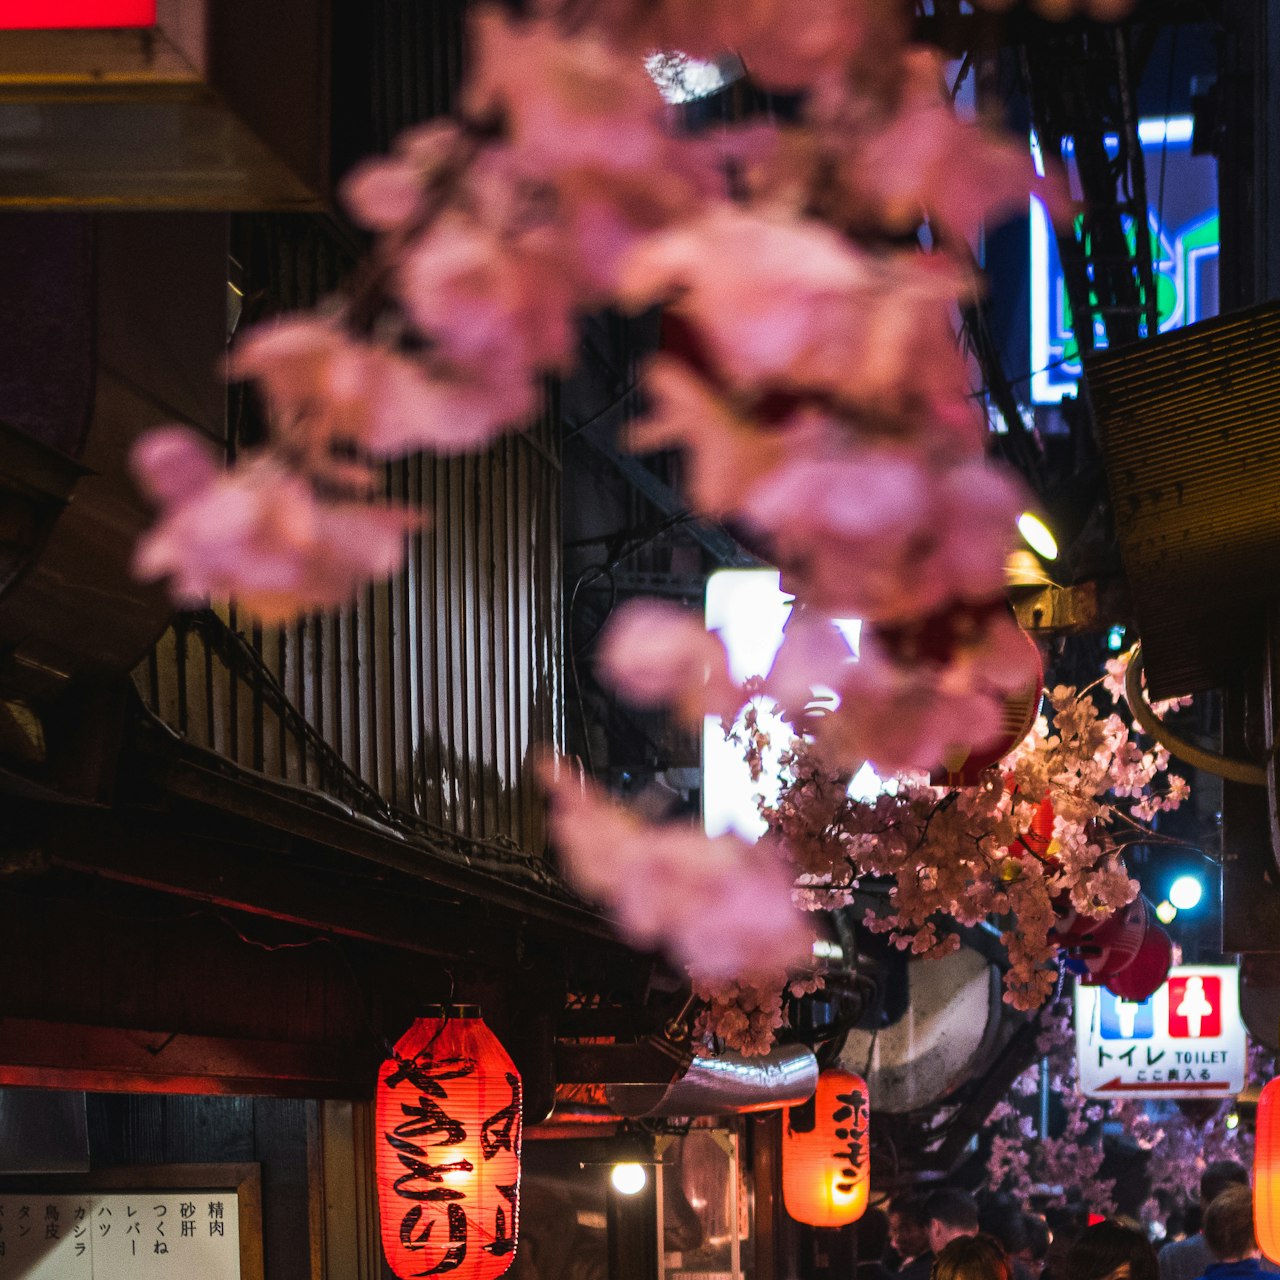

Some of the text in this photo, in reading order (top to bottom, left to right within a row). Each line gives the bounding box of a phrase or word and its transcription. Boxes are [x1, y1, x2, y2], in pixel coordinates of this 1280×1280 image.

[1098, 1045, 1229, 1068] トイレ TOILET
[18, 1204, 32, 1238] タン
[44, 1204, 60, 1240] 鳥皮
[72, 1204, 88, 1257] カシラ
[98, 1205, 113, 1237] ハツ
[125, 1204, 140, 1256] レバー
[152, 1204, 169, 1255] つくね
[180, 1202, 197, 1238] 砂肝
[207, 1201, 225, 1237] 精肉
